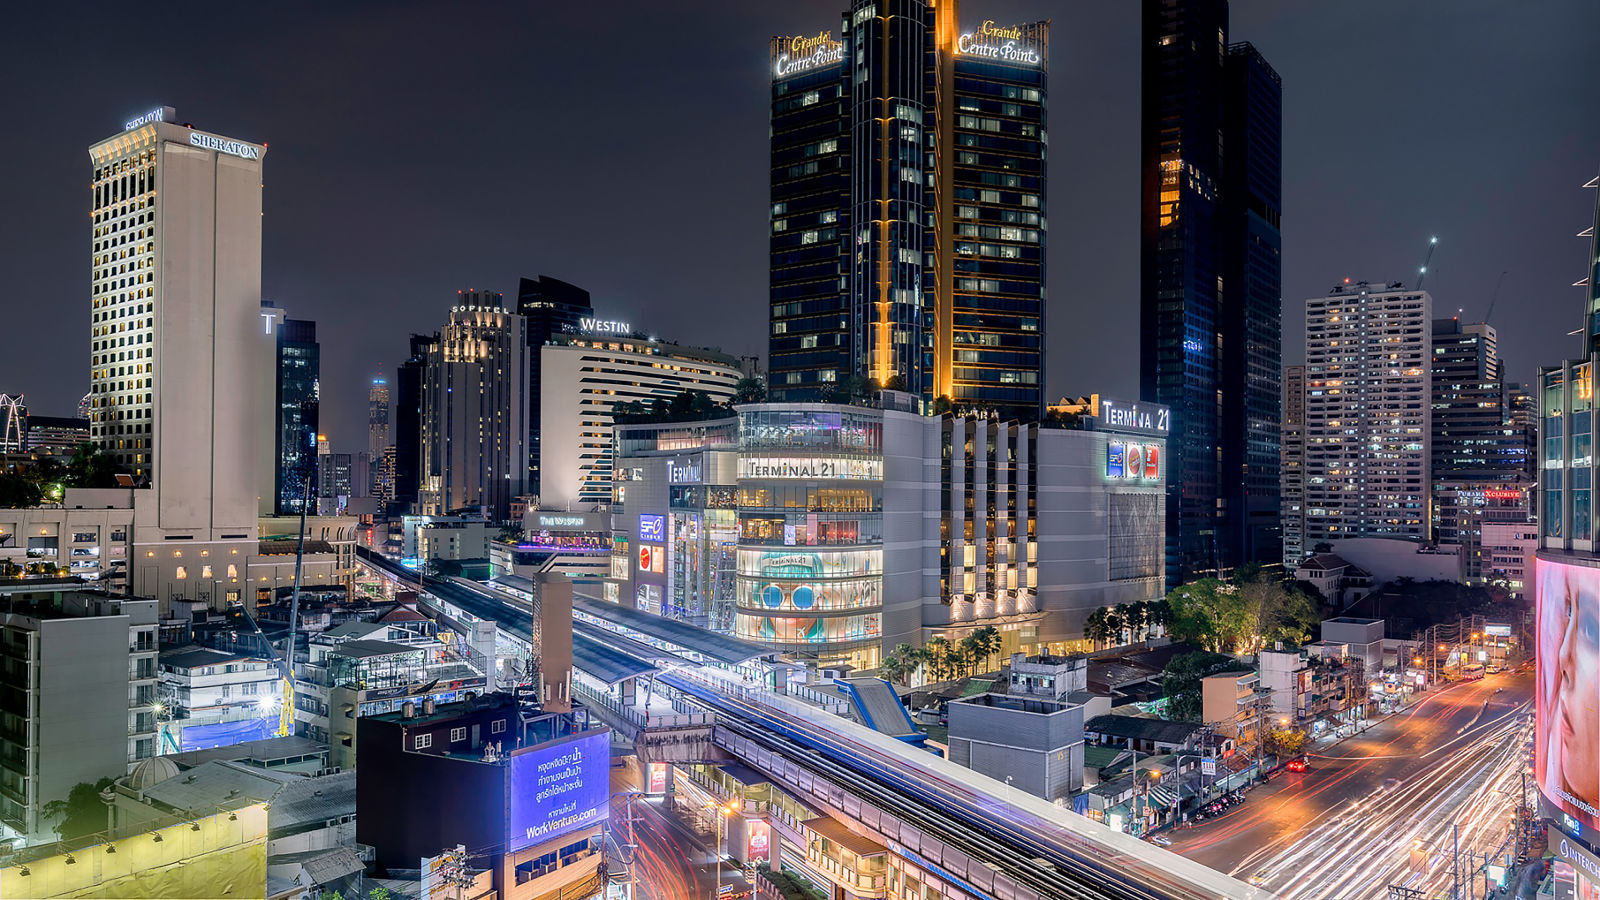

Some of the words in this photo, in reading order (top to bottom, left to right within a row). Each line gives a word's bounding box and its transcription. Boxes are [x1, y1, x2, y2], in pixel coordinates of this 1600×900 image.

[791, 31, 828, 52] Grande
[982, 19, 1022, 41] Grande
[958, 33, 999, 59] Centre
[1000, 41, 1039, 64] Point
[776, 53, 812, 77] Centre
[190, 132, 259, 160] SHERATON
[526, 807, 597, 840] WorkVenture.com
